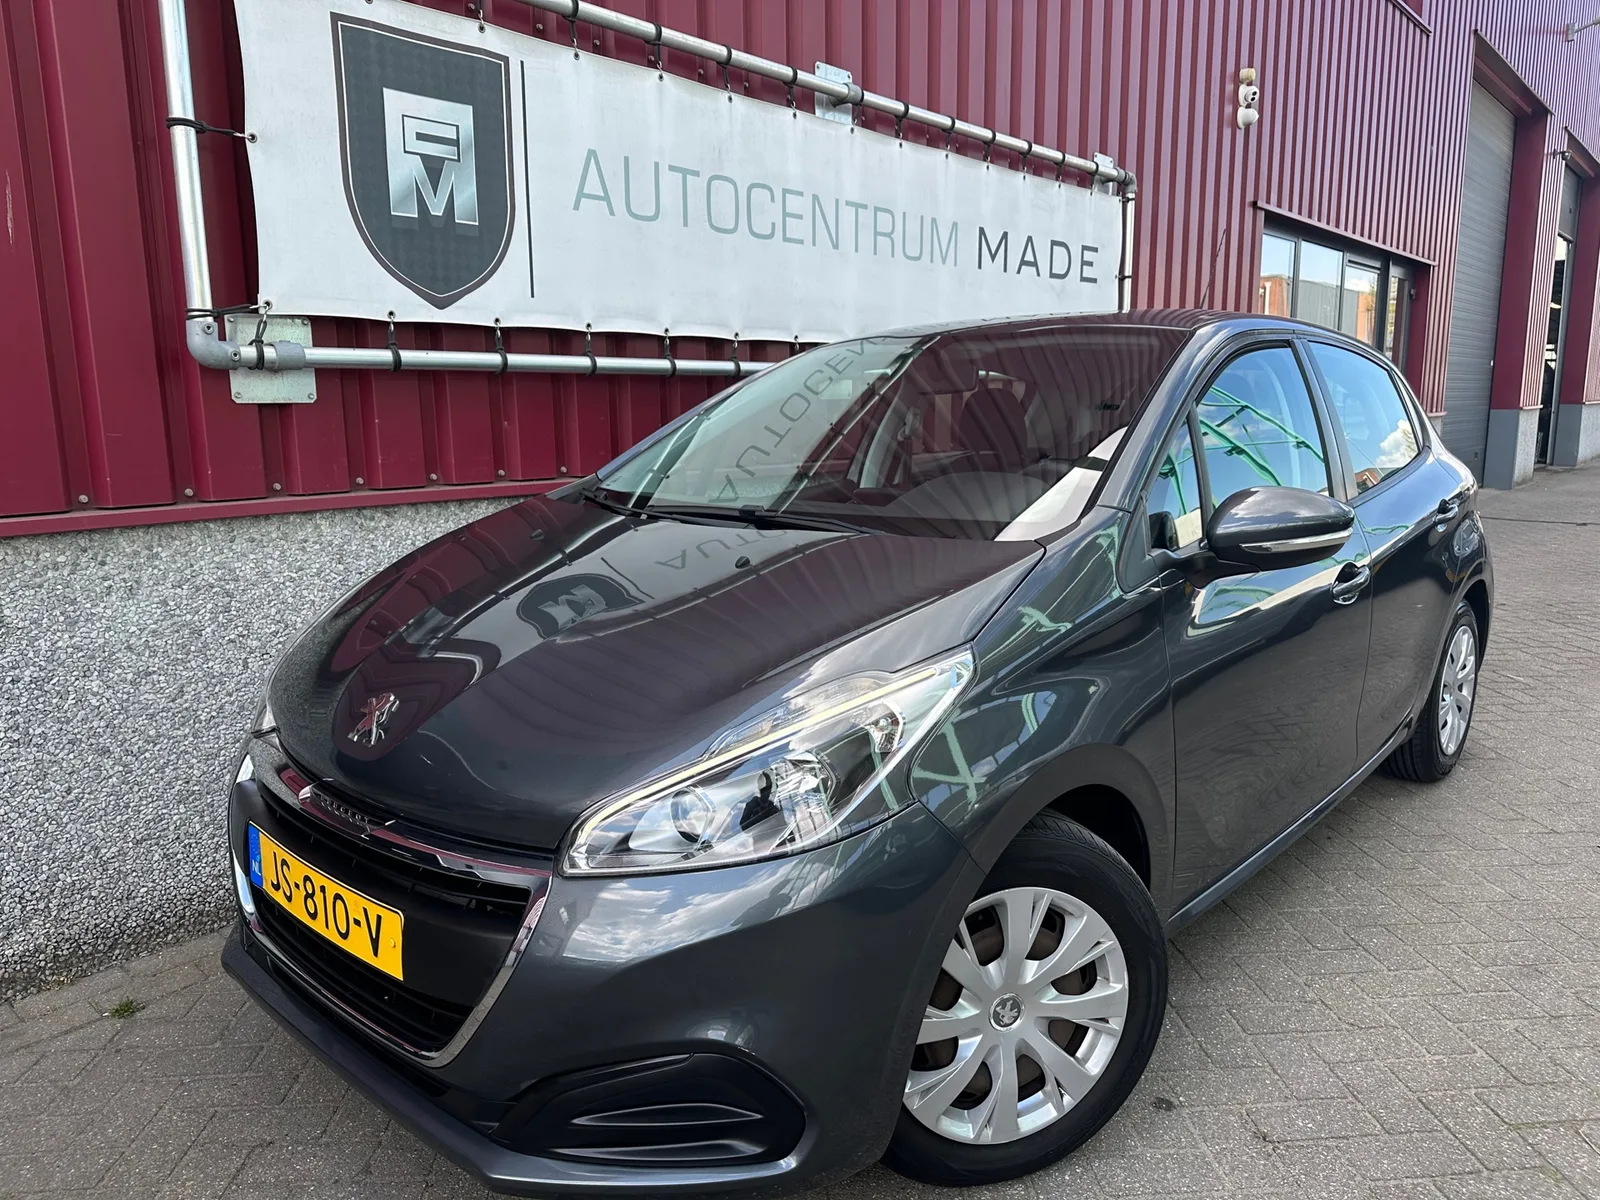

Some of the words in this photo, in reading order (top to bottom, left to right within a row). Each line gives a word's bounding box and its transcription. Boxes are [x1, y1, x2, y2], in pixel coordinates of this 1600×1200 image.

[572, 148, 958, 267] AUTOCENTRUM
[977, 226, 1099, 284] MADE
[252, 860, 262, 876] NL
[270, 851, 382, 958] JS-810-V
